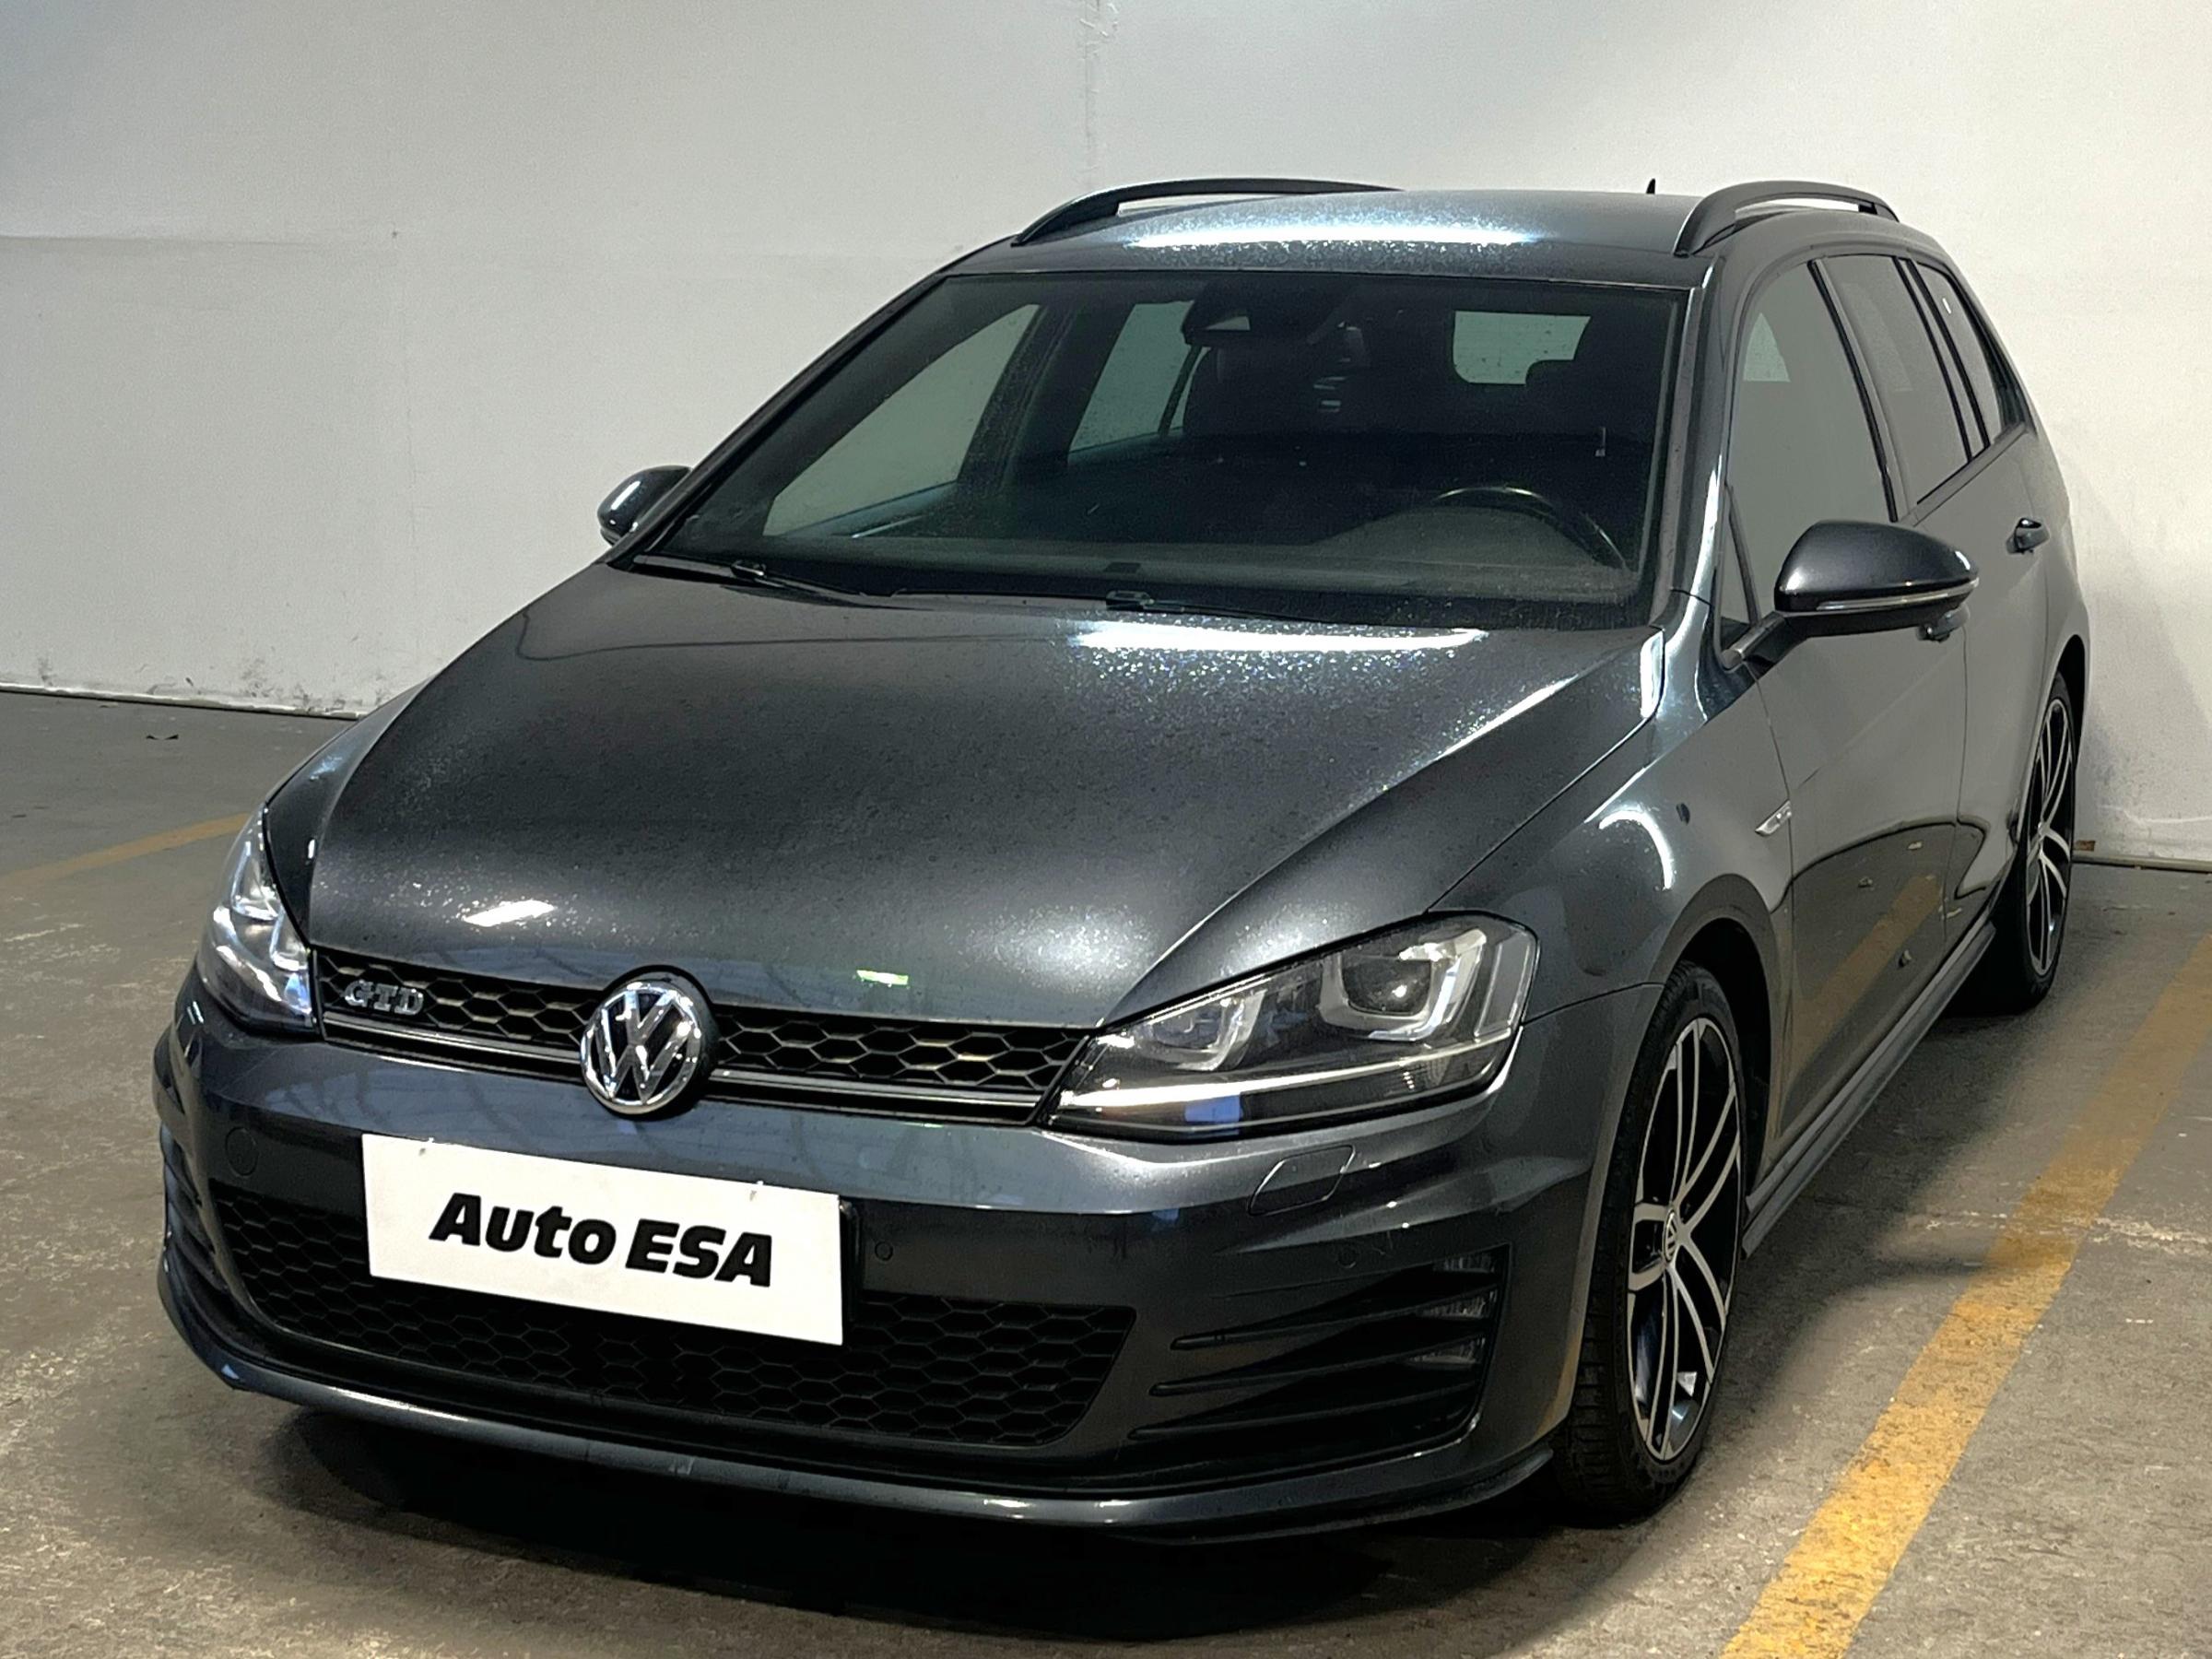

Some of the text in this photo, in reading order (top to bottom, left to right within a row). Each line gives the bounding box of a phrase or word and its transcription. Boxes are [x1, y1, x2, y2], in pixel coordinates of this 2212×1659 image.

[344, 980, 424, 1015] GTD
[584, 982, 701, 1112] VW
[429, 1193, 772, 1288] Auto ESA
